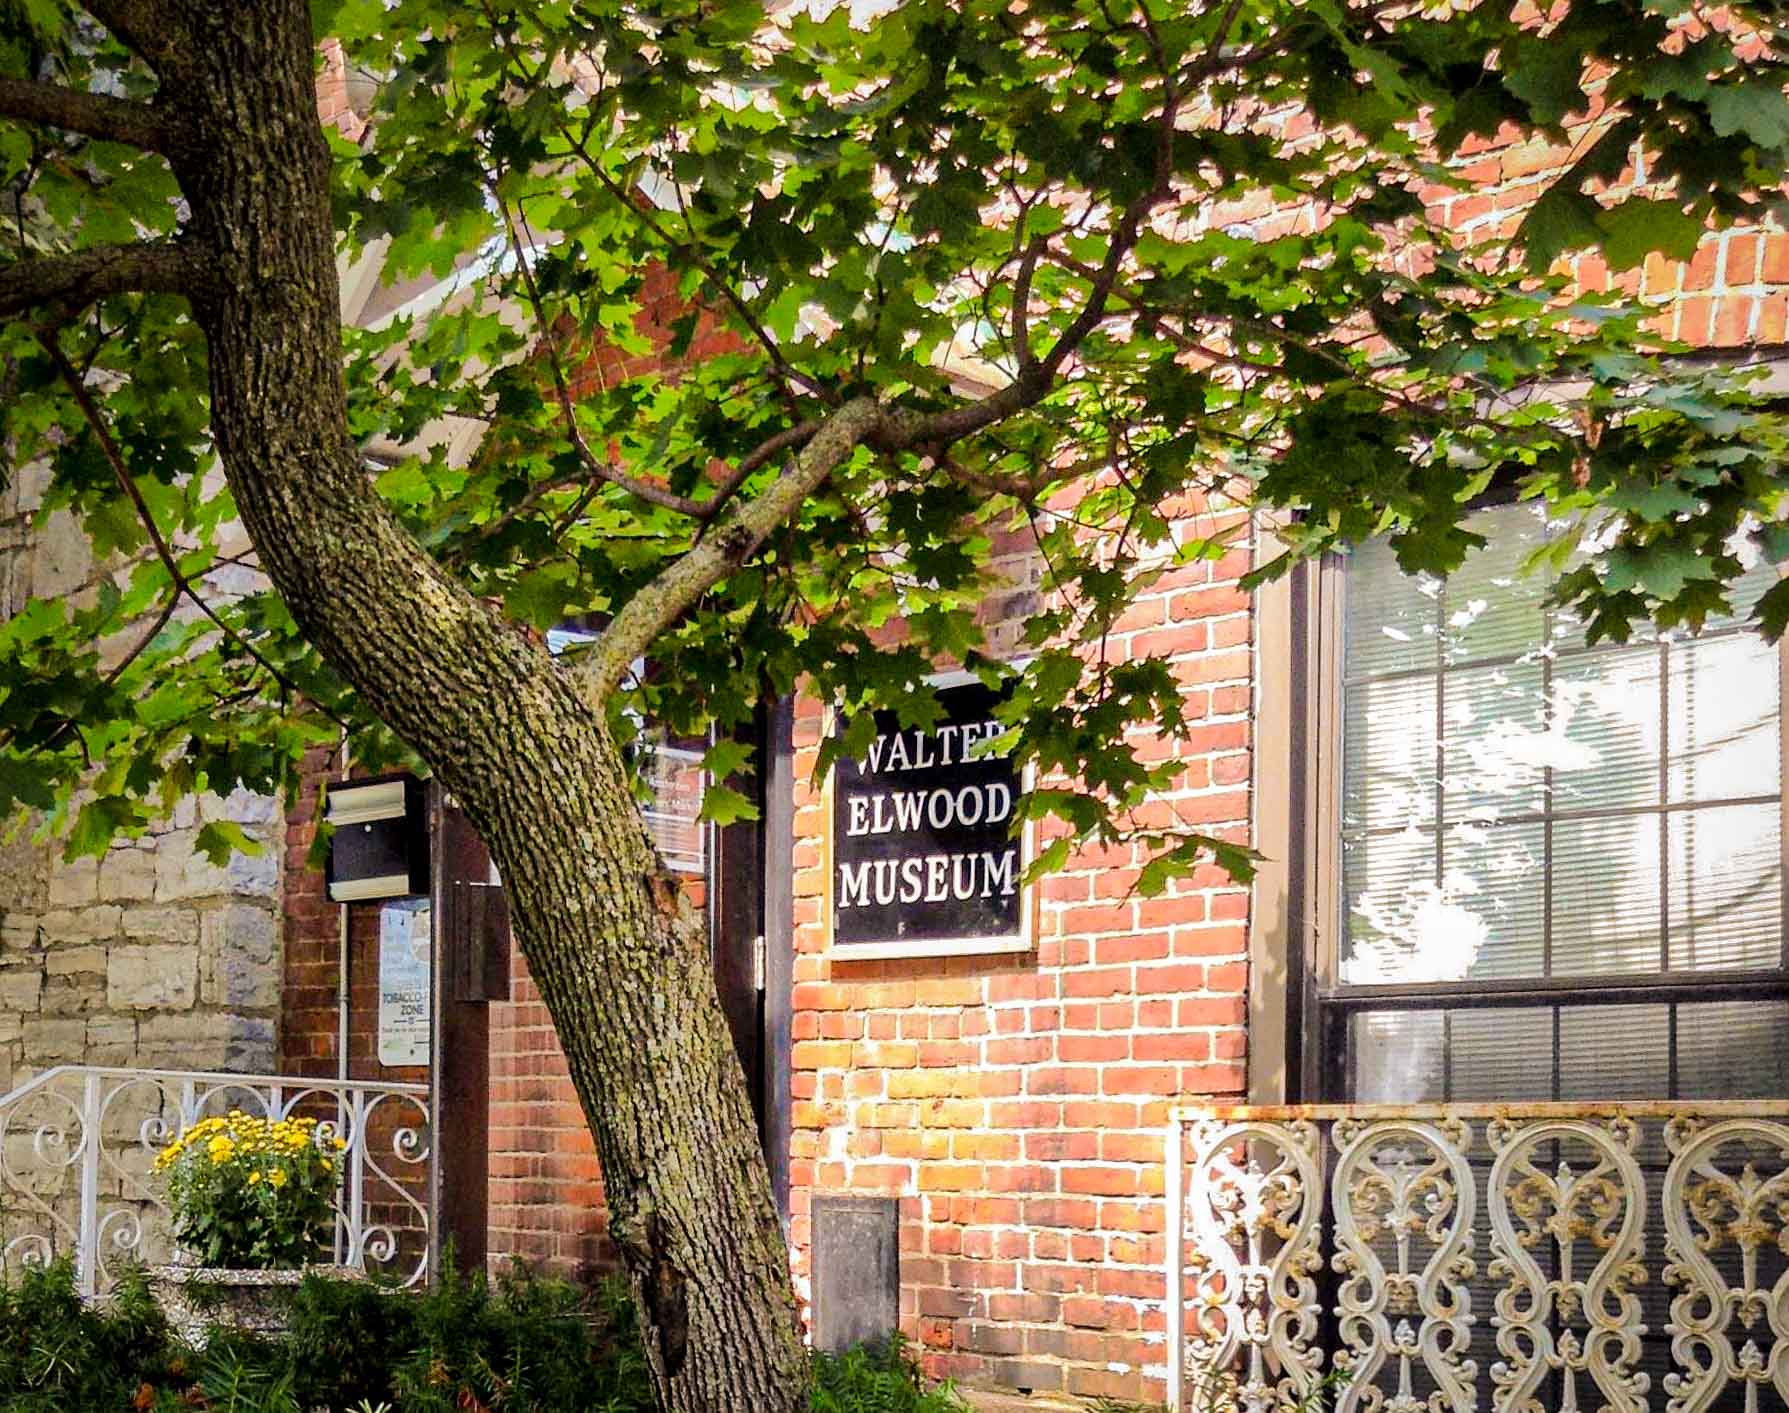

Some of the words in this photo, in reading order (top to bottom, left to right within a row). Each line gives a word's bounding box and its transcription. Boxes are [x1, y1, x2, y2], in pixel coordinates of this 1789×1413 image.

[847, 782, 1011, 837] ELWOOD
[838, 849, 1016, 908] MUSEUM
[400, 1004, 425, 1016] ZONE
